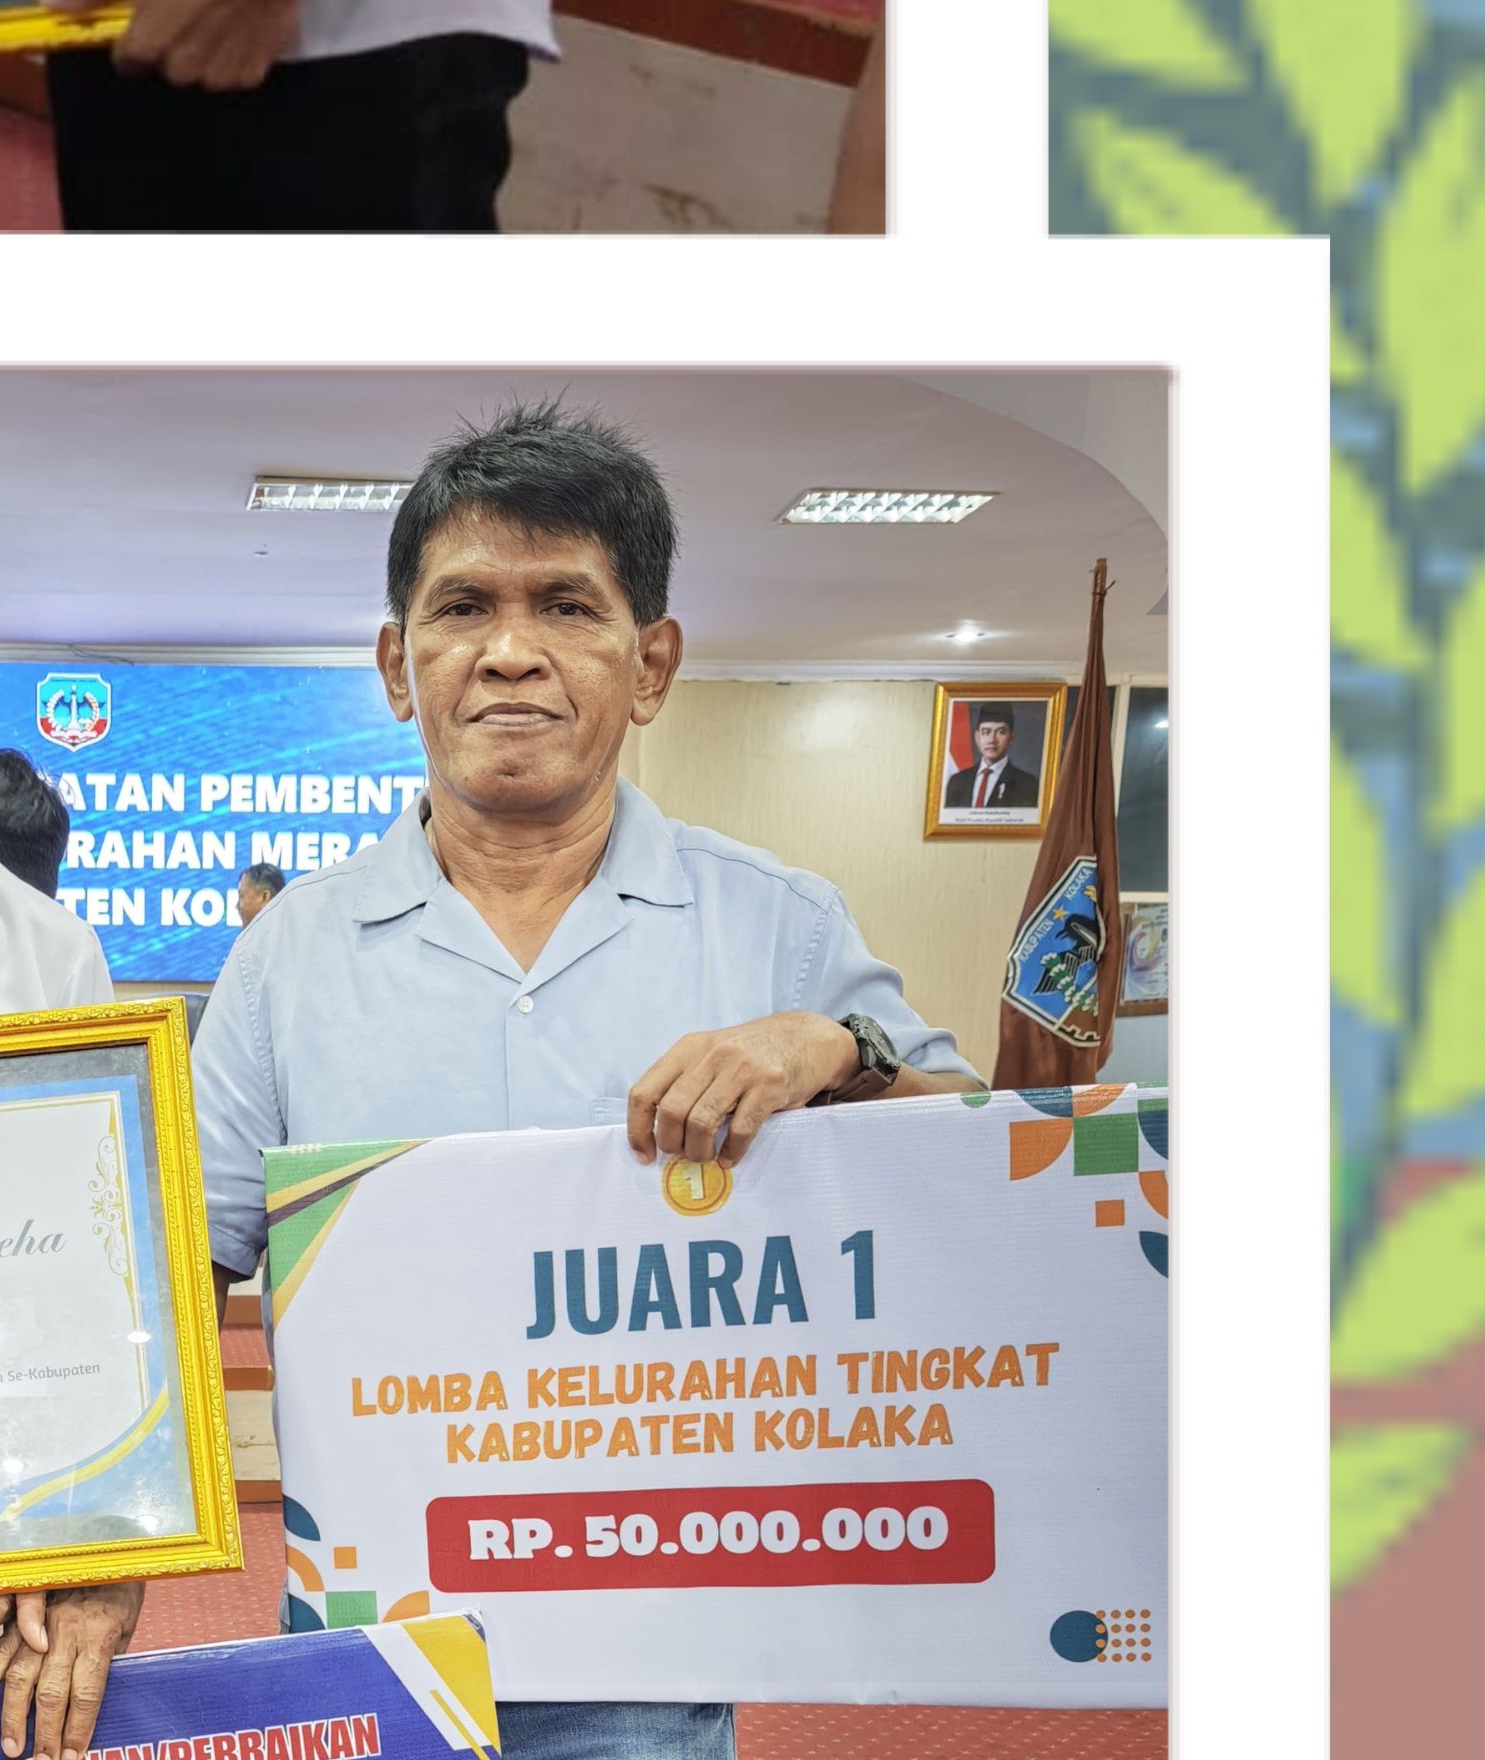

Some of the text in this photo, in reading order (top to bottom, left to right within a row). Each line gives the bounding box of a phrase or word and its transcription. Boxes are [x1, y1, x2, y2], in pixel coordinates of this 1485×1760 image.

[41, 773, 185, 812] ATAN
[200, 773, 427, 814] PEMBENT
[63, 830, 235, 870] RAHAN
[526, 1229, 877, 1340] JUARA 1
[8, 1363, 101, 1383] Se-Kabupaten
[351, 1342, 1061, 1418] LOMBA KELURAHAN TINGKAT
[446, 1403, 954, 1465] KABUPATEN KOLAKA
[584, 1505, 949, 1559] 50.000.000
